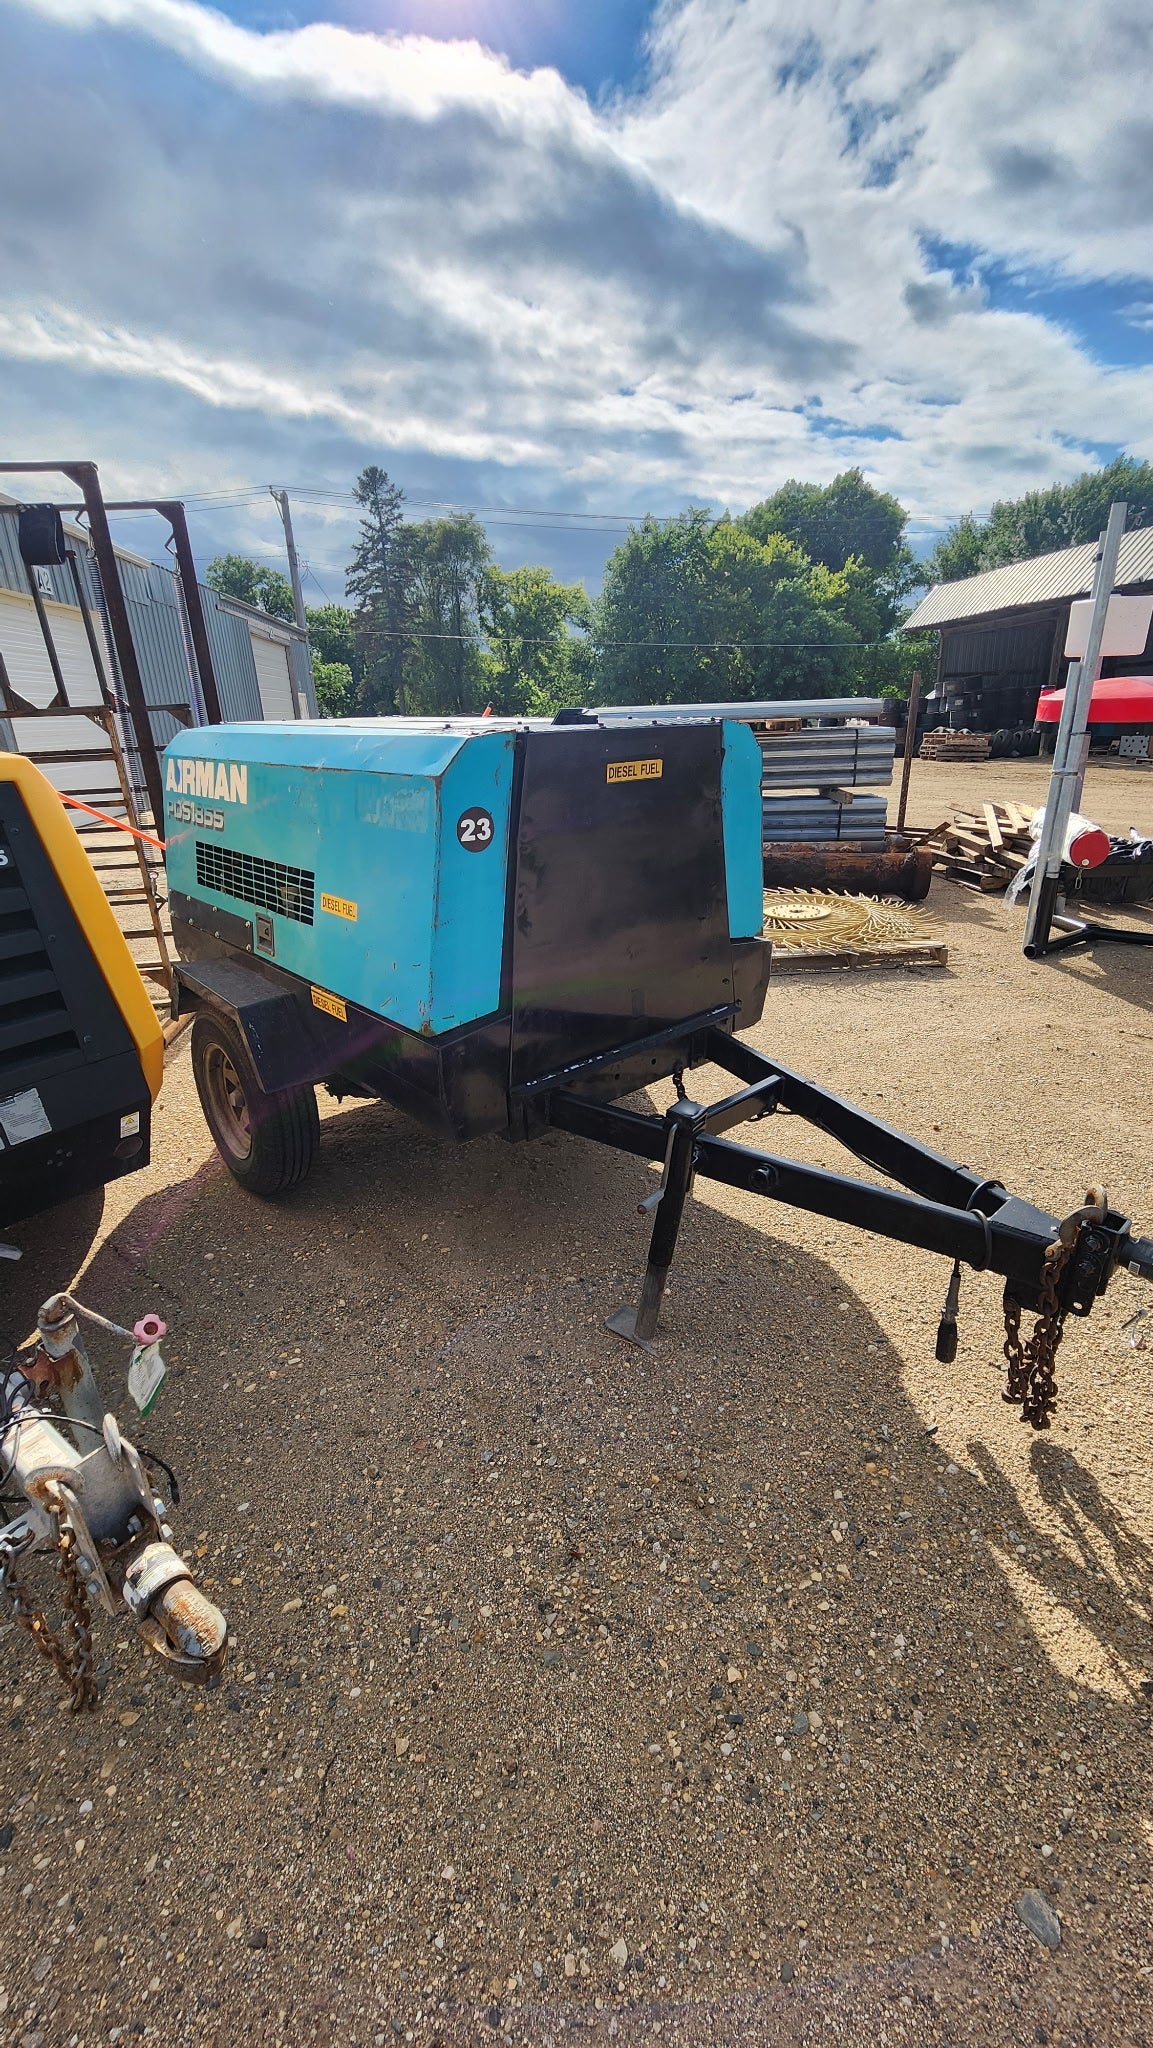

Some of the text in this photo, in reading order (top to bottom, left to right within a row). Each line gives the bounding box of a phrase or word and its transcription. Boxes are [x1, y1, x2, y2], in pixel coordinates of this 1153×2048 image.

[166, 758, 248, 804] AIRMAN
[608, 762, 660, 779] DIESEL FUEL
[460, 817, 491, 842] 23
[322, 897, 356, 918] DIESEL FUEL
[312, 994, 346, 1020] DIESEL FUEL
